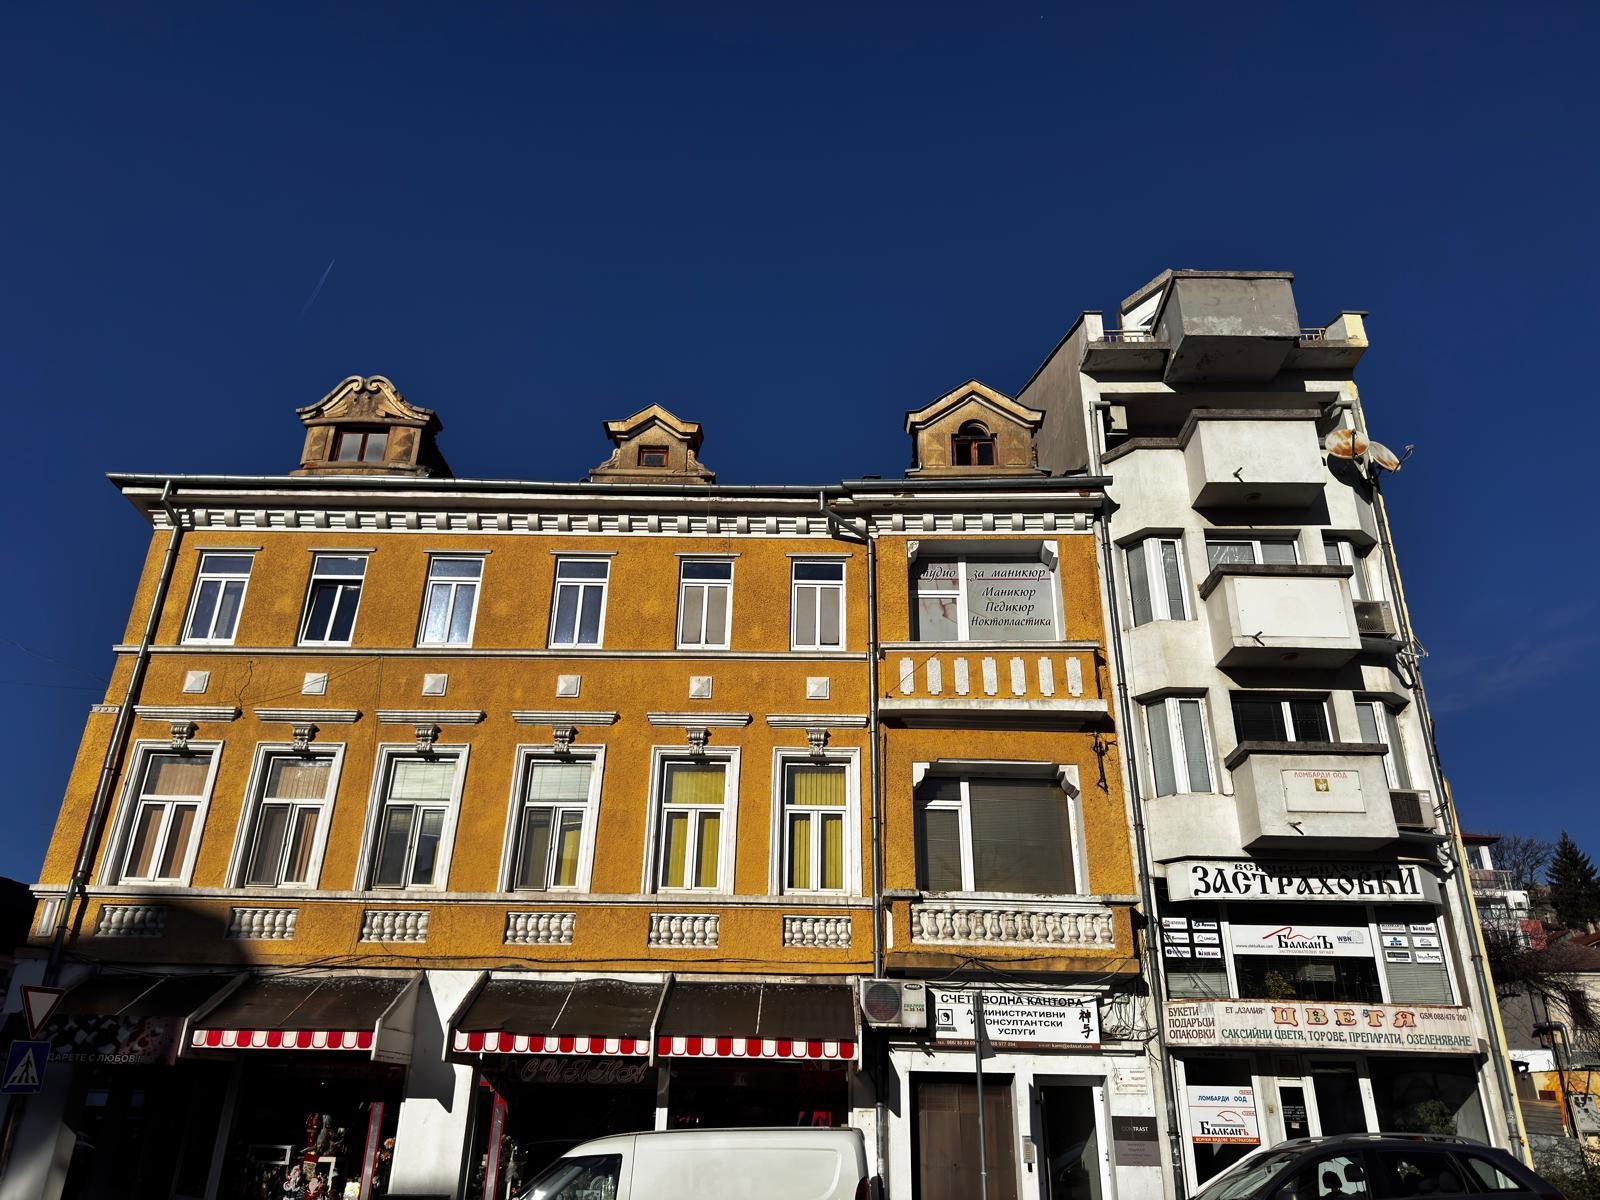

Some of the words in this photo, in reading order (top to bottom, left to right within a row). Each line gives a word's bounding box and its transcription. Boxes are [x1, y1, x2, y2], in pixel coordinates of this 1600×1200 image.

[920, 566, 956, 582] тудио
[970, 569, 985, 582] за
[991, 568, 1046, 582] маникюр
[981, 586, 1036, 598] Маникюр
[985, 601, 1035, 616] Педикюр
[970, 615, 1051, 627] Ноктопластика
[1294, 771, 1331, 779] ЛОМБАРДИ
[1191, 865, 1421, 897] ЗАСТРАХОВКИ
[940, 993, 1023, 1006] СЧЕТВОДНА
[1027, 996, 1084, 1007] КАНТОРА
[966, 1008, 1066, 1019] АМИНИСТРАТИВНИ
[1168, 1006, 1200, 1017] БУКЕТИ
[1225, 1006, 1233, 1014] ЕТ
[984, 1018, 1063, 1027] ОНСУЛТАНТСКИ
[1168, 1017, 1215, 1028] ПОДАРЪЦИ
[1270, 1006, 1417, 1028] ЦВЕТЯ
[1419, 1012, 1433, 1020] GSM
[1455, 1014, 1467, 1022] 700
[997, 1028, 1036, 1036] УСЛУГИ
[1169, 1029, 1216, 1039] ОПАКОВКИ
[1221, 1027, 1272, 1039] САКСИЙНИ
[1274, 1027, 1306, 1041] ЦВЕТЯ,
[1307, 1030, 1347, 1042] ТОРОВЕ,
[1349, 1032, 1404, 1044] ПРЕПАРАТИ,
[1406, 1033, 1472, 1047] ОЗЕЛЕНЯВАНЕ
